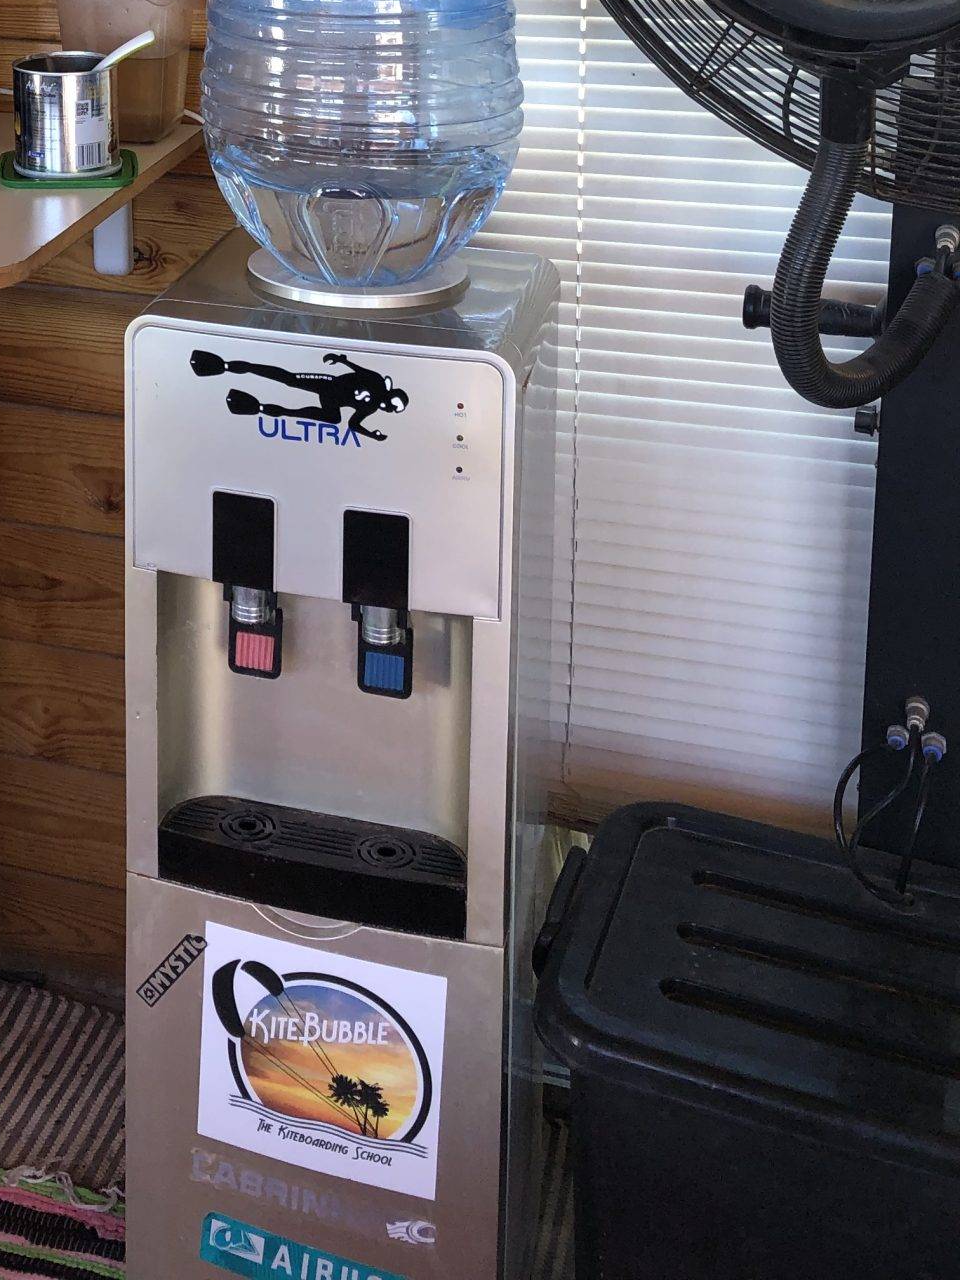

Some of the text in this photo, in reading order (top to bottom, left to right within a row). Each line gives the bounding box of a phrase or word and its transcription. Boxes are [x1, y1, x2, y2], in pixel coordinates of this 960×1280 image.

[295, 373, 333, 382] SCUBAPRO
[258, 416, 361, 448] ULTRA
[148, 937, 207, 996] MYSTIC
